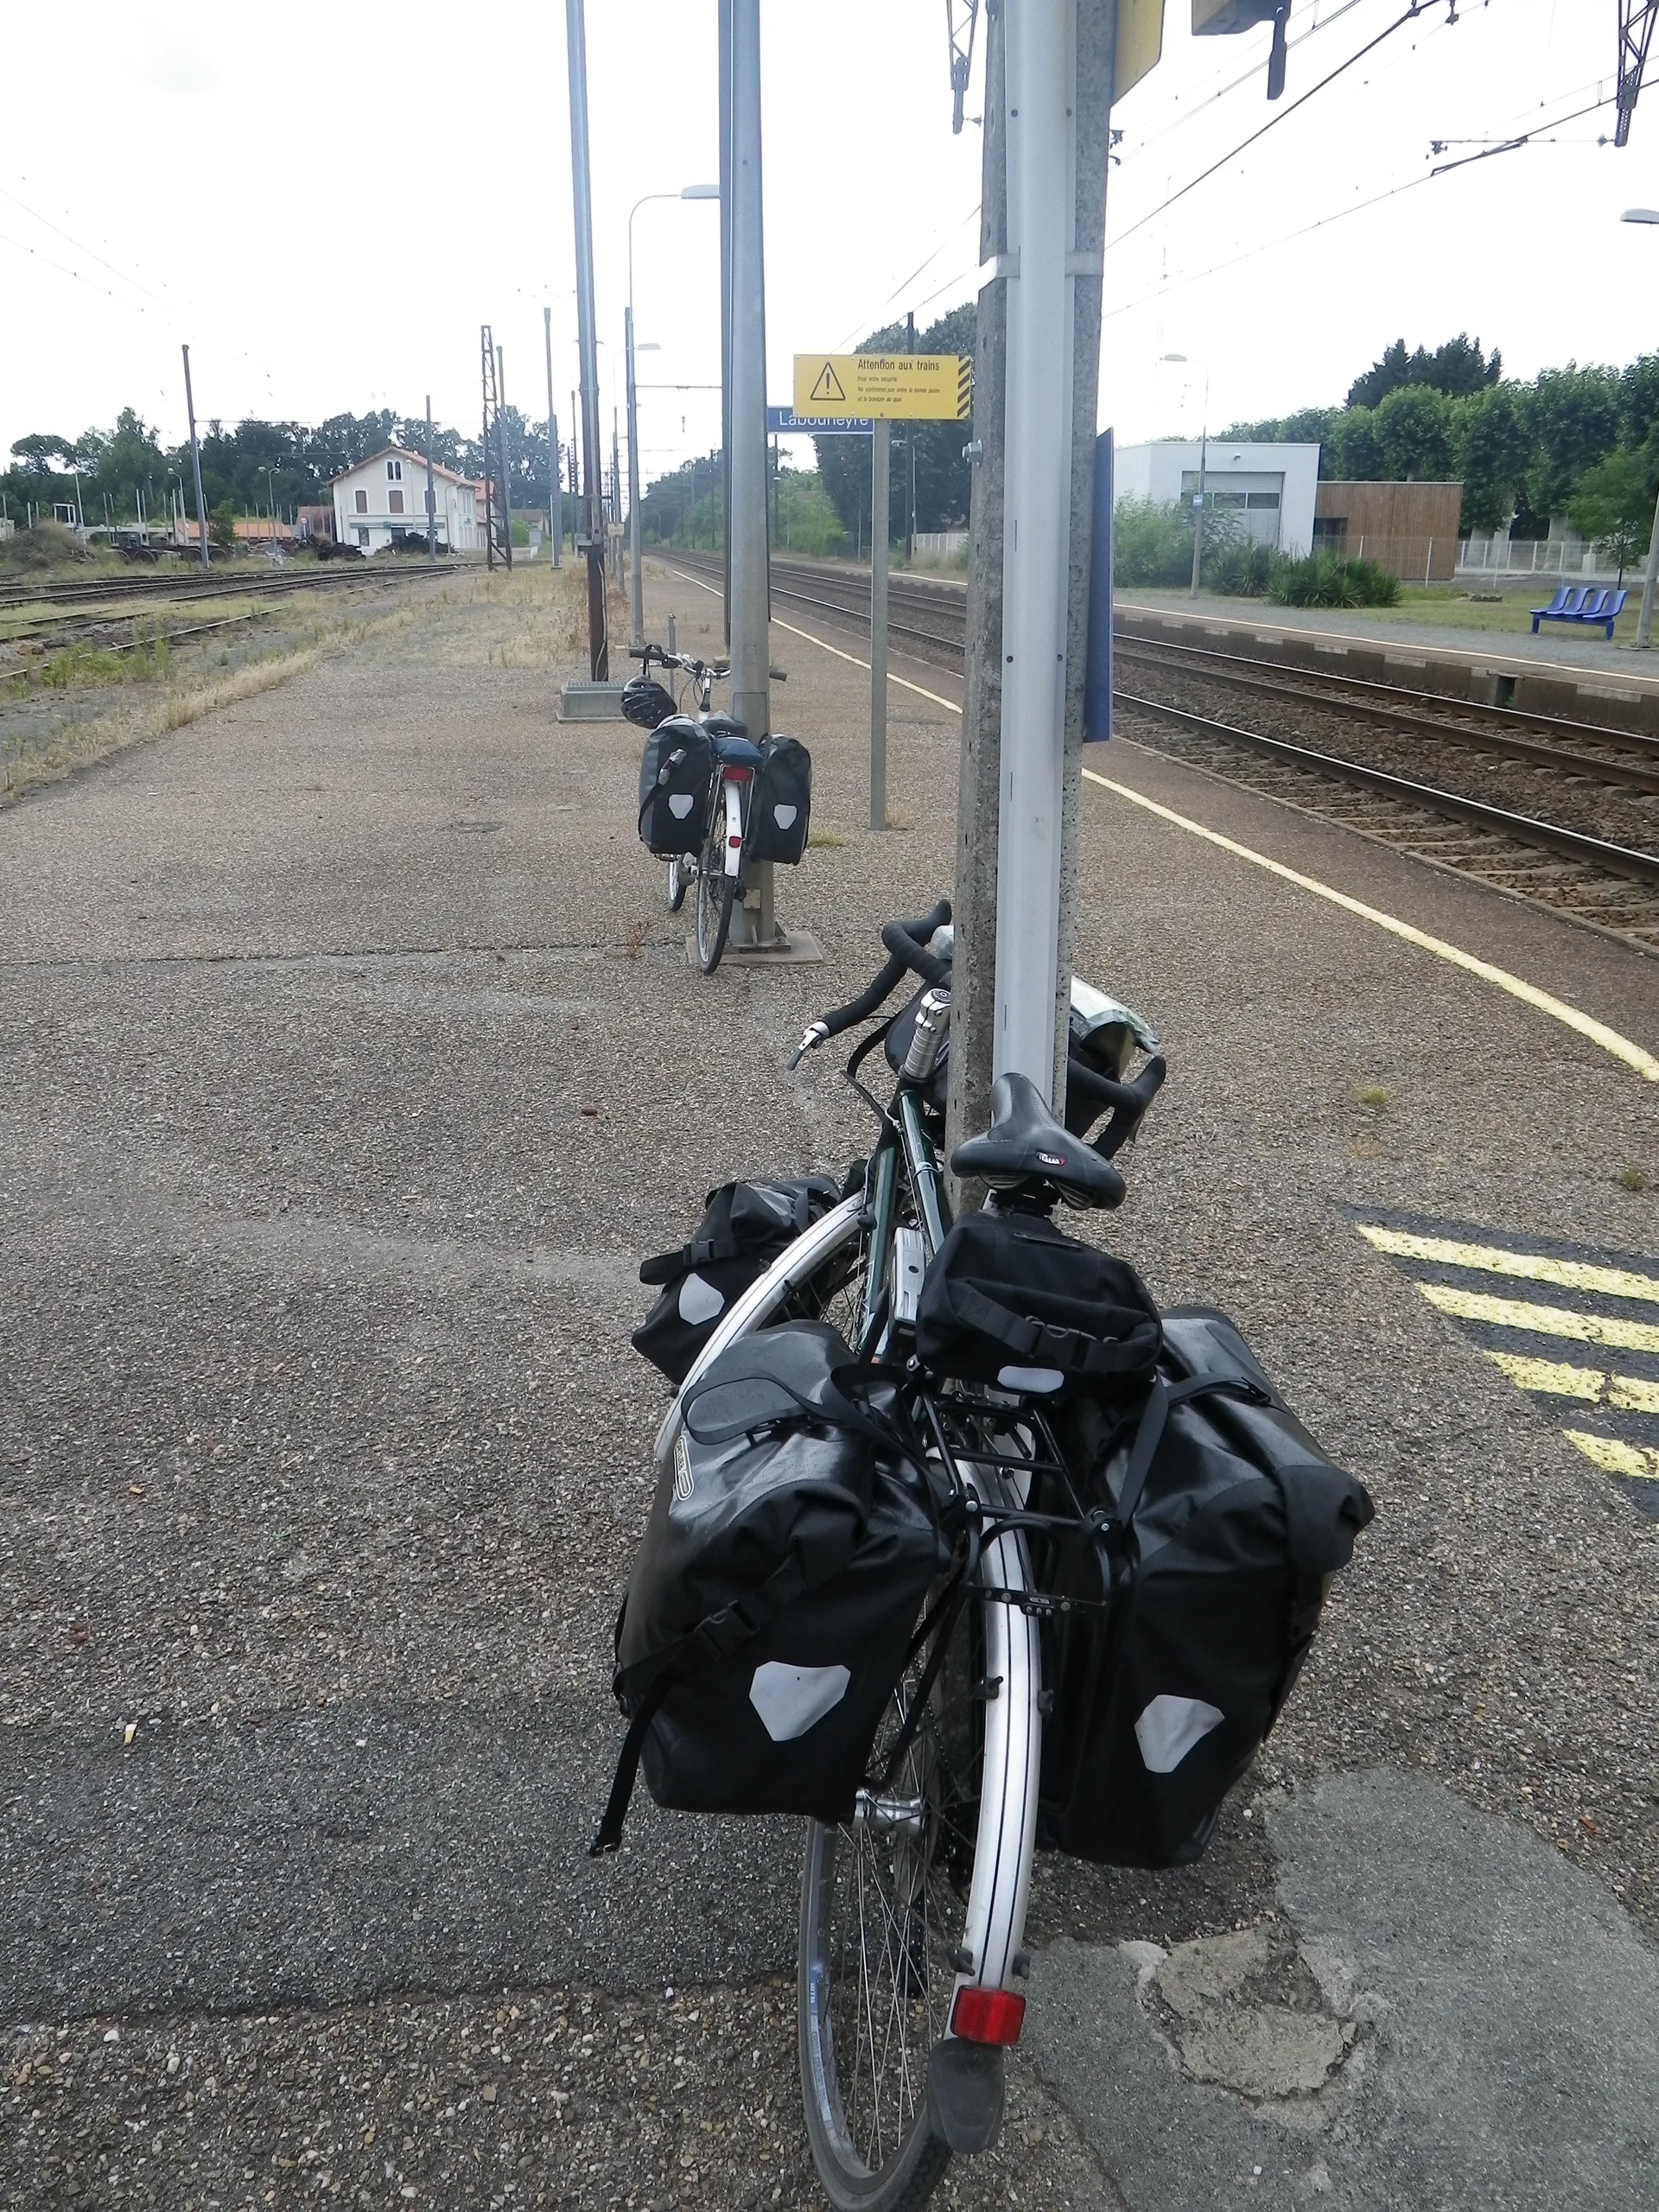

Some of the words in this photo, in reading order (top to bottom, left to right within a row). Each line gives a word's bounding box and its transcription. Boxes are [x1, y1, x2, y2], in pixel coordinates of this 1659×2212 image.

[857, 359, 894, 370] Attention
[899, 361, 913, 370] aux
[917, 360, 940, 371] trains
